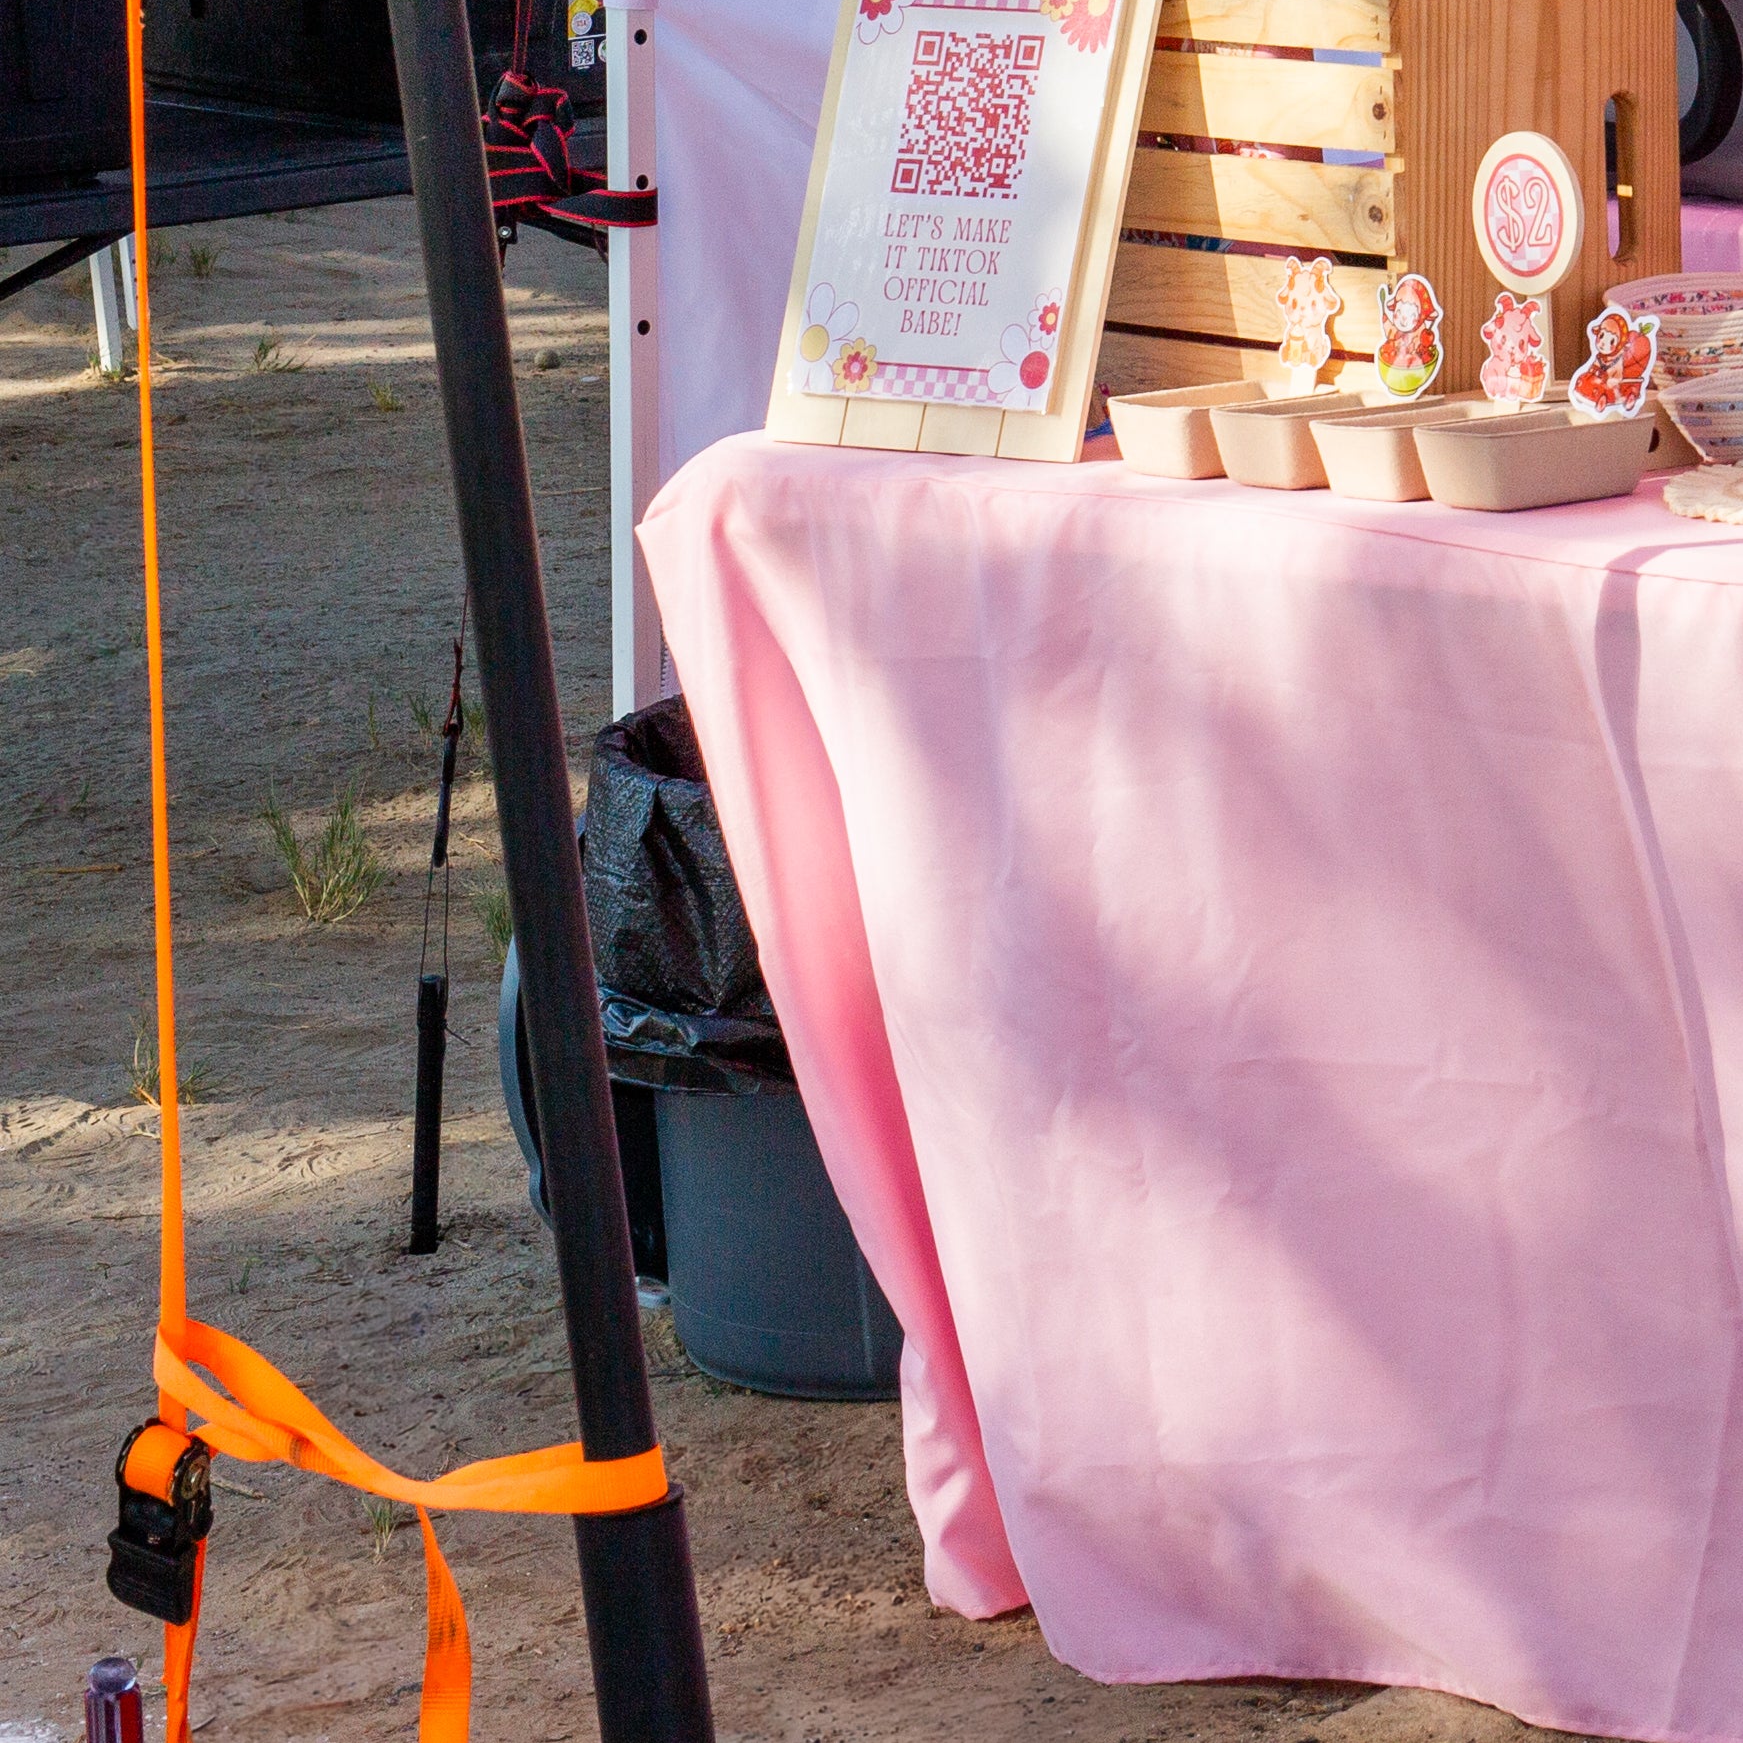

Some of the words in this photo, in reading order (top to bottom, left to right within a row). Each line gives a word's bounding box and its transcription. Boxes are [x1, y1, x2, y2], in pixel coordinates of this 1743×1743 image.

[883, 213, 945, 242] LET'S
[953, 216, 1012, 245] MAKE
[1494, 175, 1554, 253] $2
[884, 245, 910, 271] IT
[916, 247, 1001, 277] TIKTOK
[883, 277, 990, 307] OFFICIAL
[900, 310, 961, 338] BABE!
